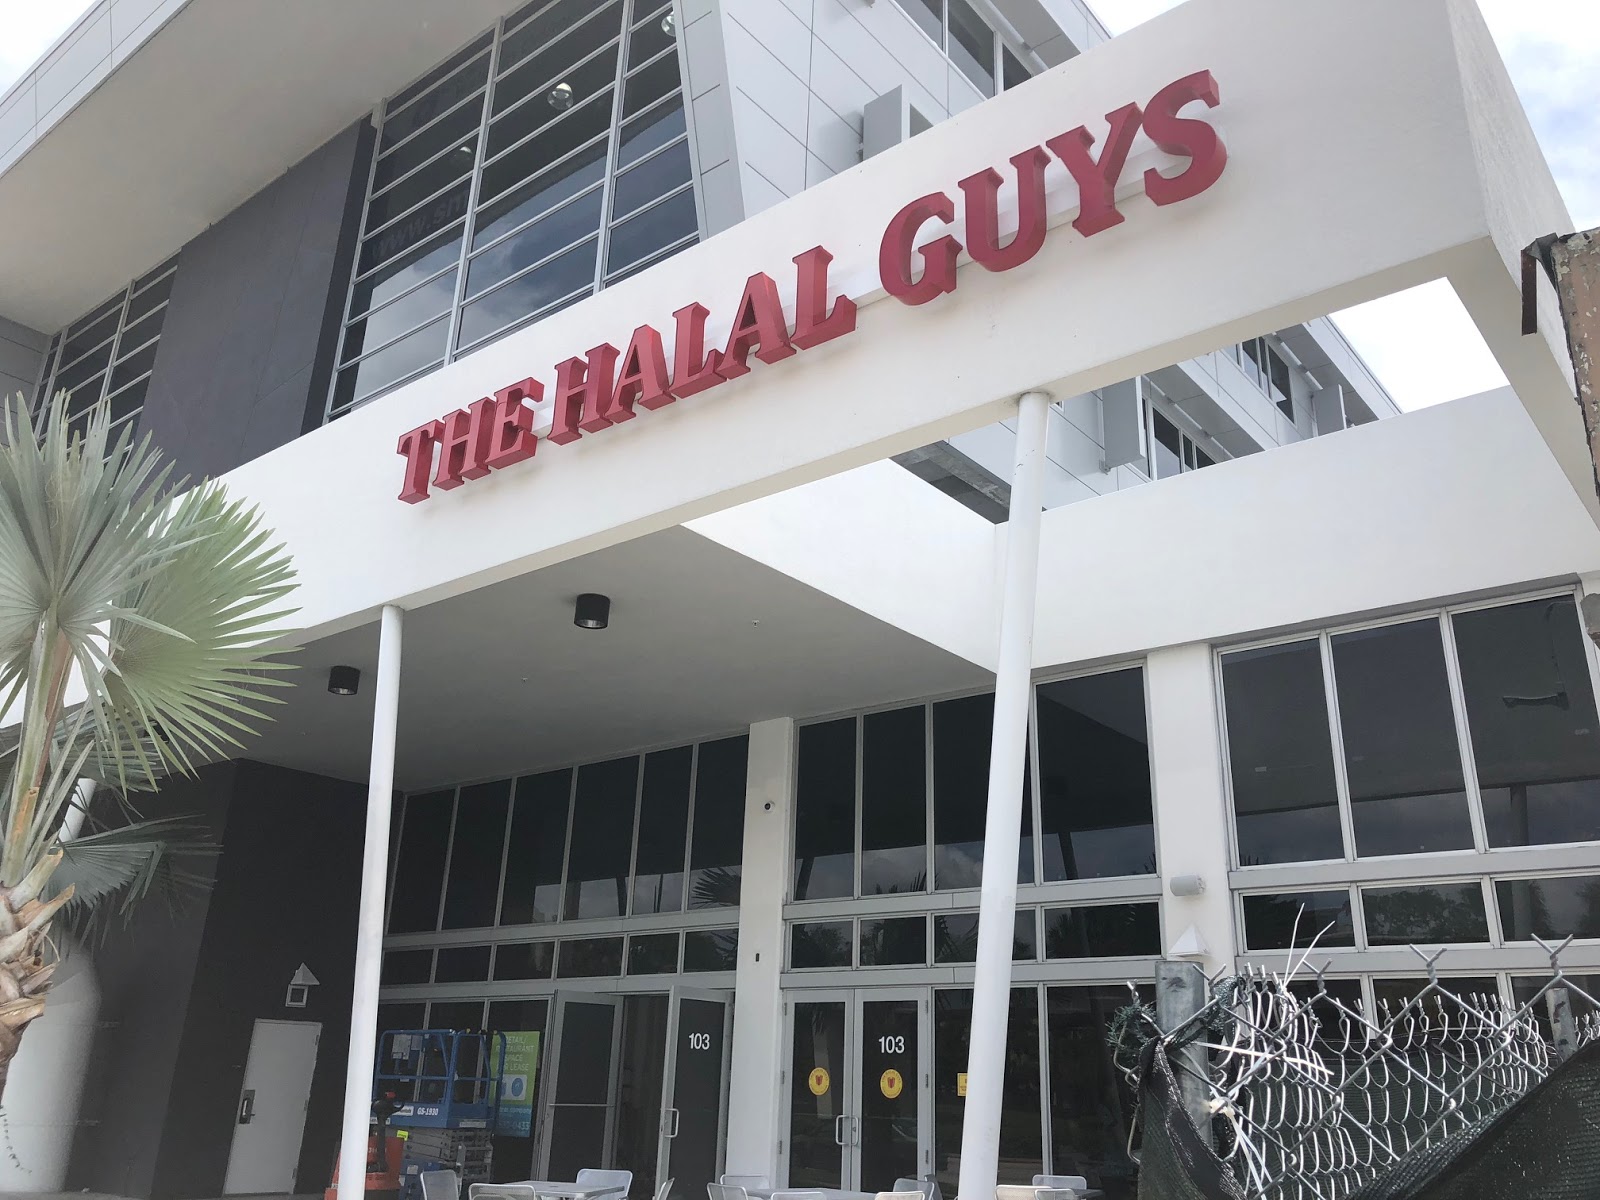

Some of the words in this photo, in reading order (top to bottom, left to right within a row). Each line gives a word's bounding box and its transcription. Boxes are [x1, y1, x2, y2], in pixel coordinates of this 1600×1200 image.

[397, 376, 545, 504] THE
[547, 245, 857, 446] HALAL
[879, 69, 1227, 306] GUYS
[689, 1033, 710, 1050] 103
[879, 1036, 905, 1053] 103
[417, 1107, 439, 1116] GS-1930
